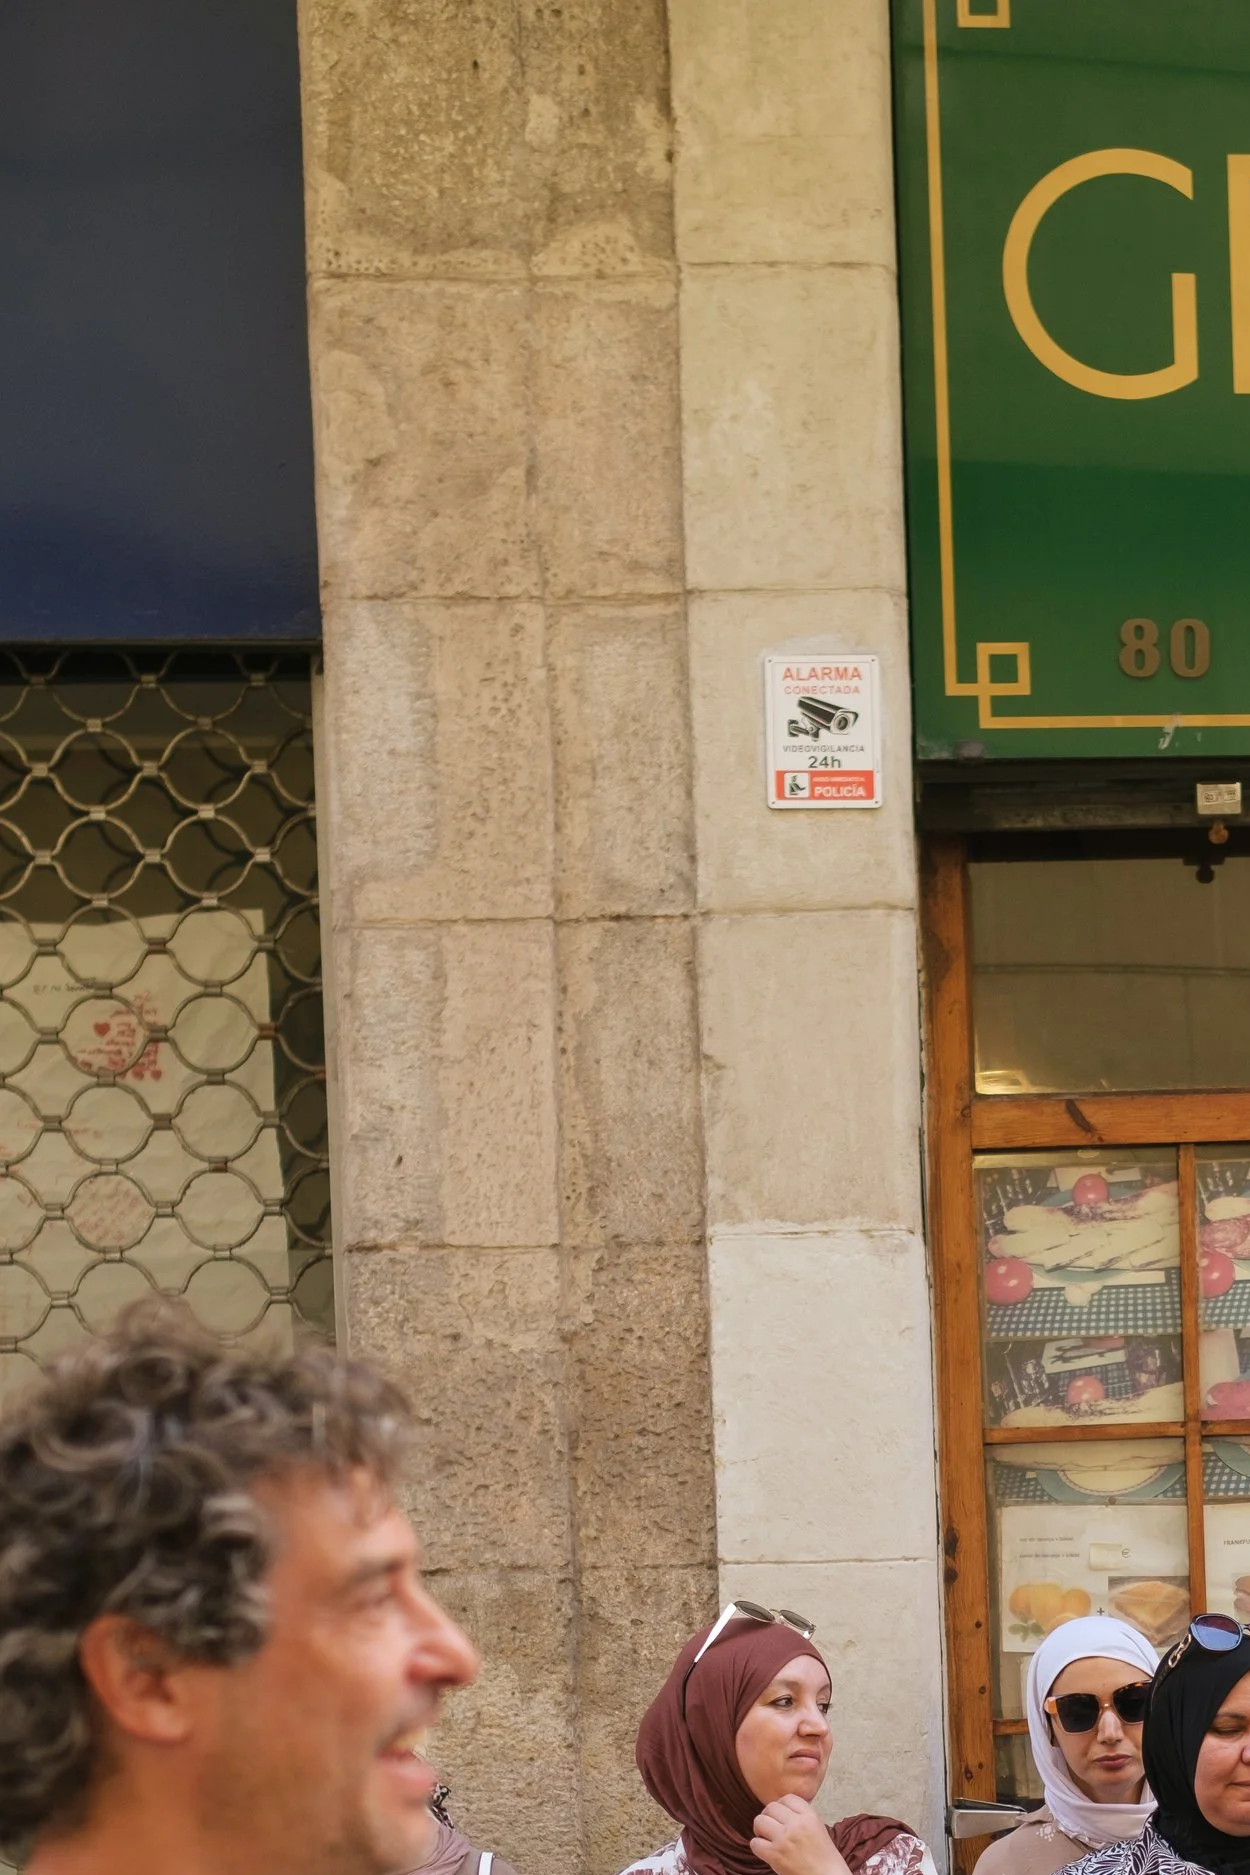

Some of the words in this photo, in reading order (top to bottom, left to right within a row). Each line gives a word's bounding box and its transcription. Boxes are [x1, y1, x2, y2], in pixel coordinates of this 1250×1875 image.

[1119, 618, 1210, 678] 80
[782, 666, 862, 681] ALARMA
[784, 685, 861, 695] CONECTADA
[782, 744, 865, 753] VIDEOVIGILANCIA
[808, 755, 842, 769] 24h
[813, 784, 866, 797] POLICÍA
